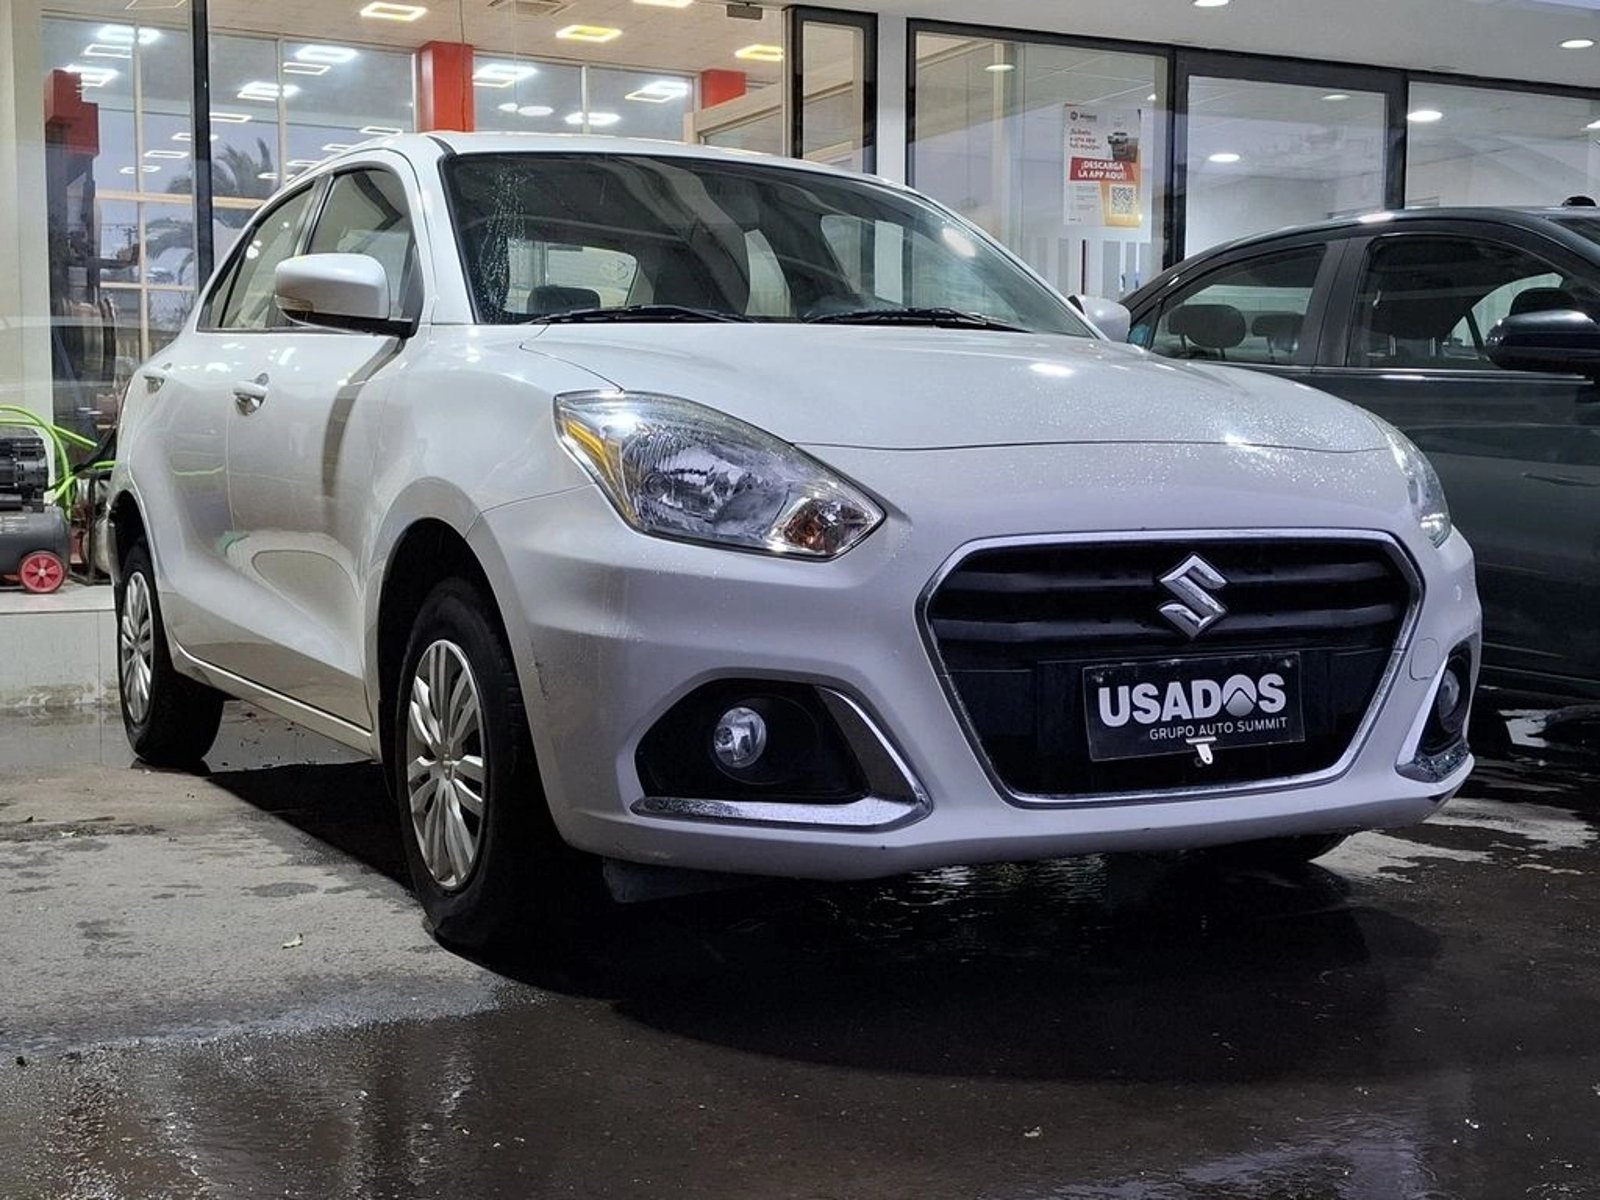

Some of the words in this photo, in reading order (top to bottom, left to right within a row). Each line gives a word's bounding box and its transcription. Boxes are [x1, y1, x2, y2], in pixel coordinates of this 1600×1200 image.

[1080, 160, 1124, 170] ¡DESCARGA
[1078, 170, 1088, 178] LA
[1089, 171, 1104, 179] APP
[1098, 673, 1287, 727] USADOS
[1149, 725, 1195, 740] GRUPO
[1199, 721, 1234, 736] AUTO
[1237, 716, 1289, 732] SUMMIT
